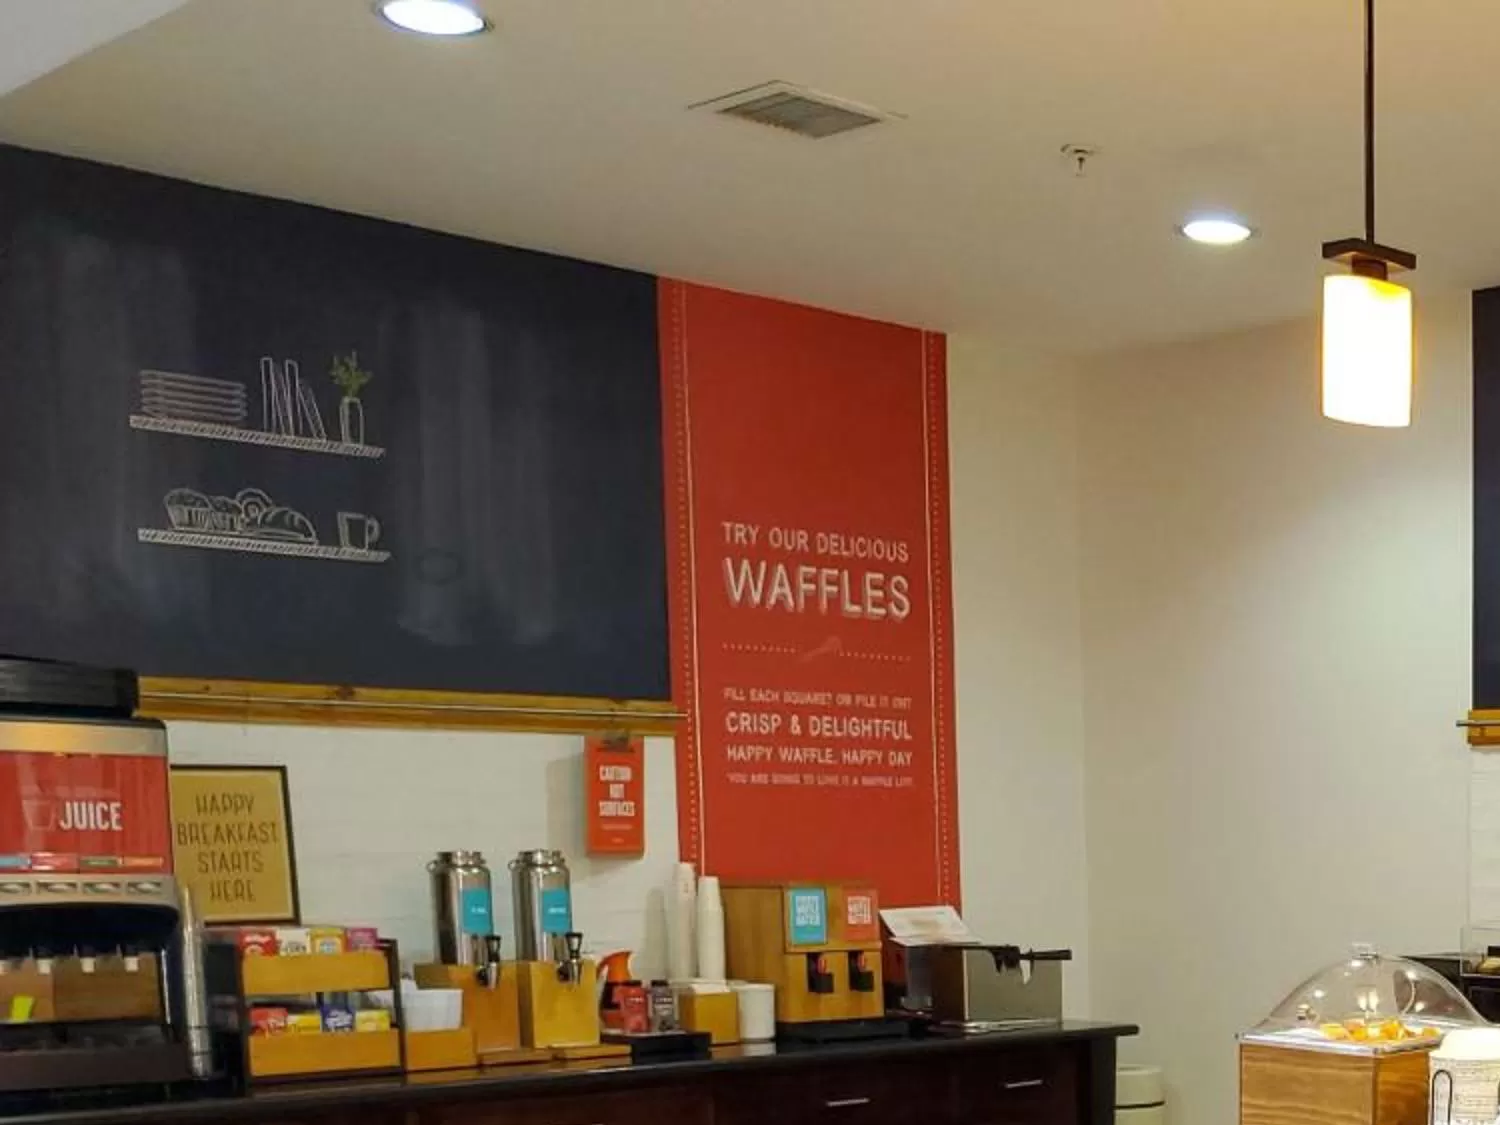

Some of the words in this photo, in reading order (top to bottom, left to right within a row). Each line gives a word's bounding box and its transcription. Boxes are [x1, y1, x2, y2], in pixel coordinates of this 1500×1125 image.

[723, 521, 760, 545] TRY
[768, 527, 809, 552] OUR
[816, 532, 909, 562] DELICIOUS
[725, 556, 911, 620] WAFFLES
[725, 711, 782, 734] CRISP
[790, 714, 801, 736] &
[809, 716, 912, 740] DELIGHTFUL
[727, 744, 772, 761] HAPPY
[842, 748, 883, 765] HAPPY
[889, 751, 912, 766] DAY
[59, 801, 123, 831] JUICE
[195, 793, 255, 816] HAPPY
[177, 821, 279, 846] BREAKFAST
[197, 851, 265, 873] STARTS
[210, 879, 256, 902] HERE
